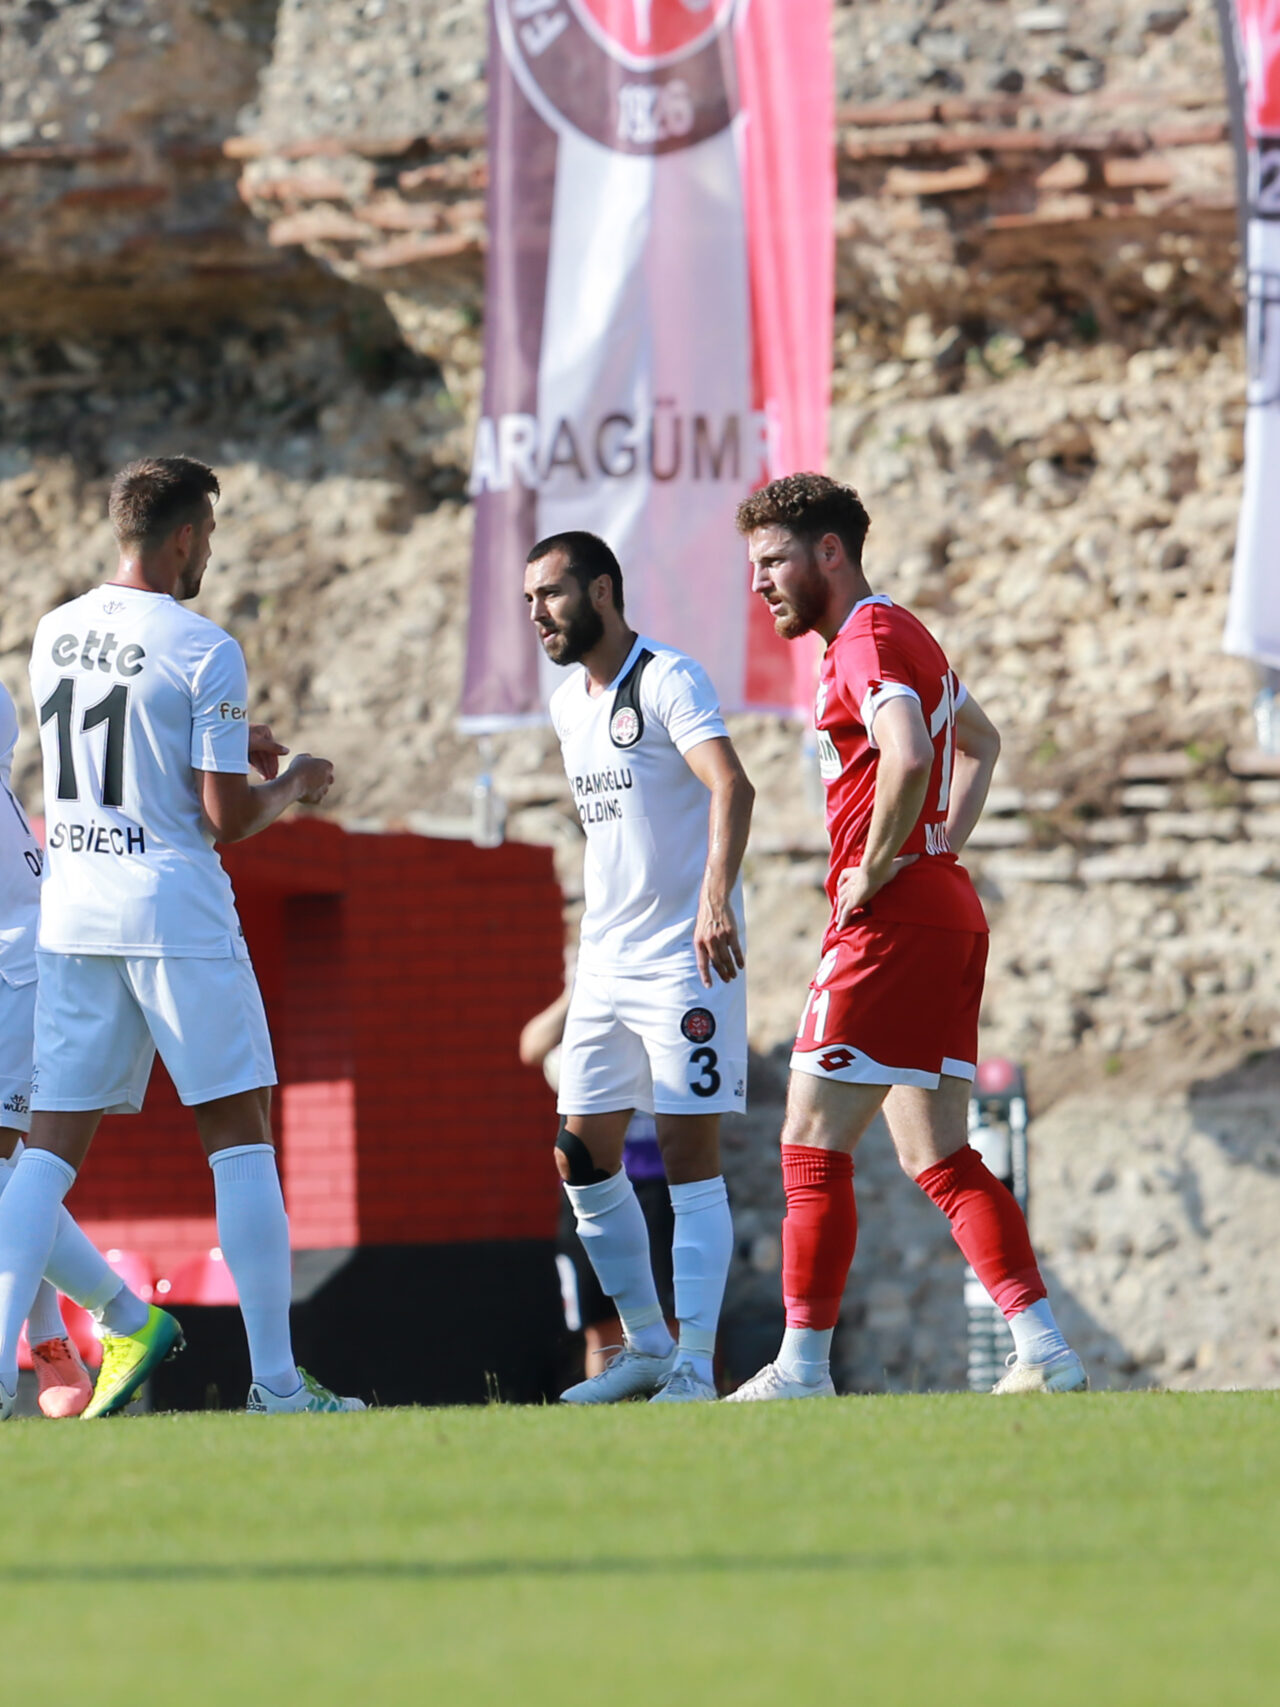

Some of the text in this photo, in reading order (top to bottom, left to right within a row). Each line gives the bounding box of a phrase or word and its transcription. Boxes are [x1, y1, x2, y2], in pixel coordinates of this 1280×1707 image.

[51, 629, 146, 677] ette
[39, 675, 131, 810] 11
[578, 796, 623, 824] OLDİNG
[689, 1046, 722, 1098] 3
